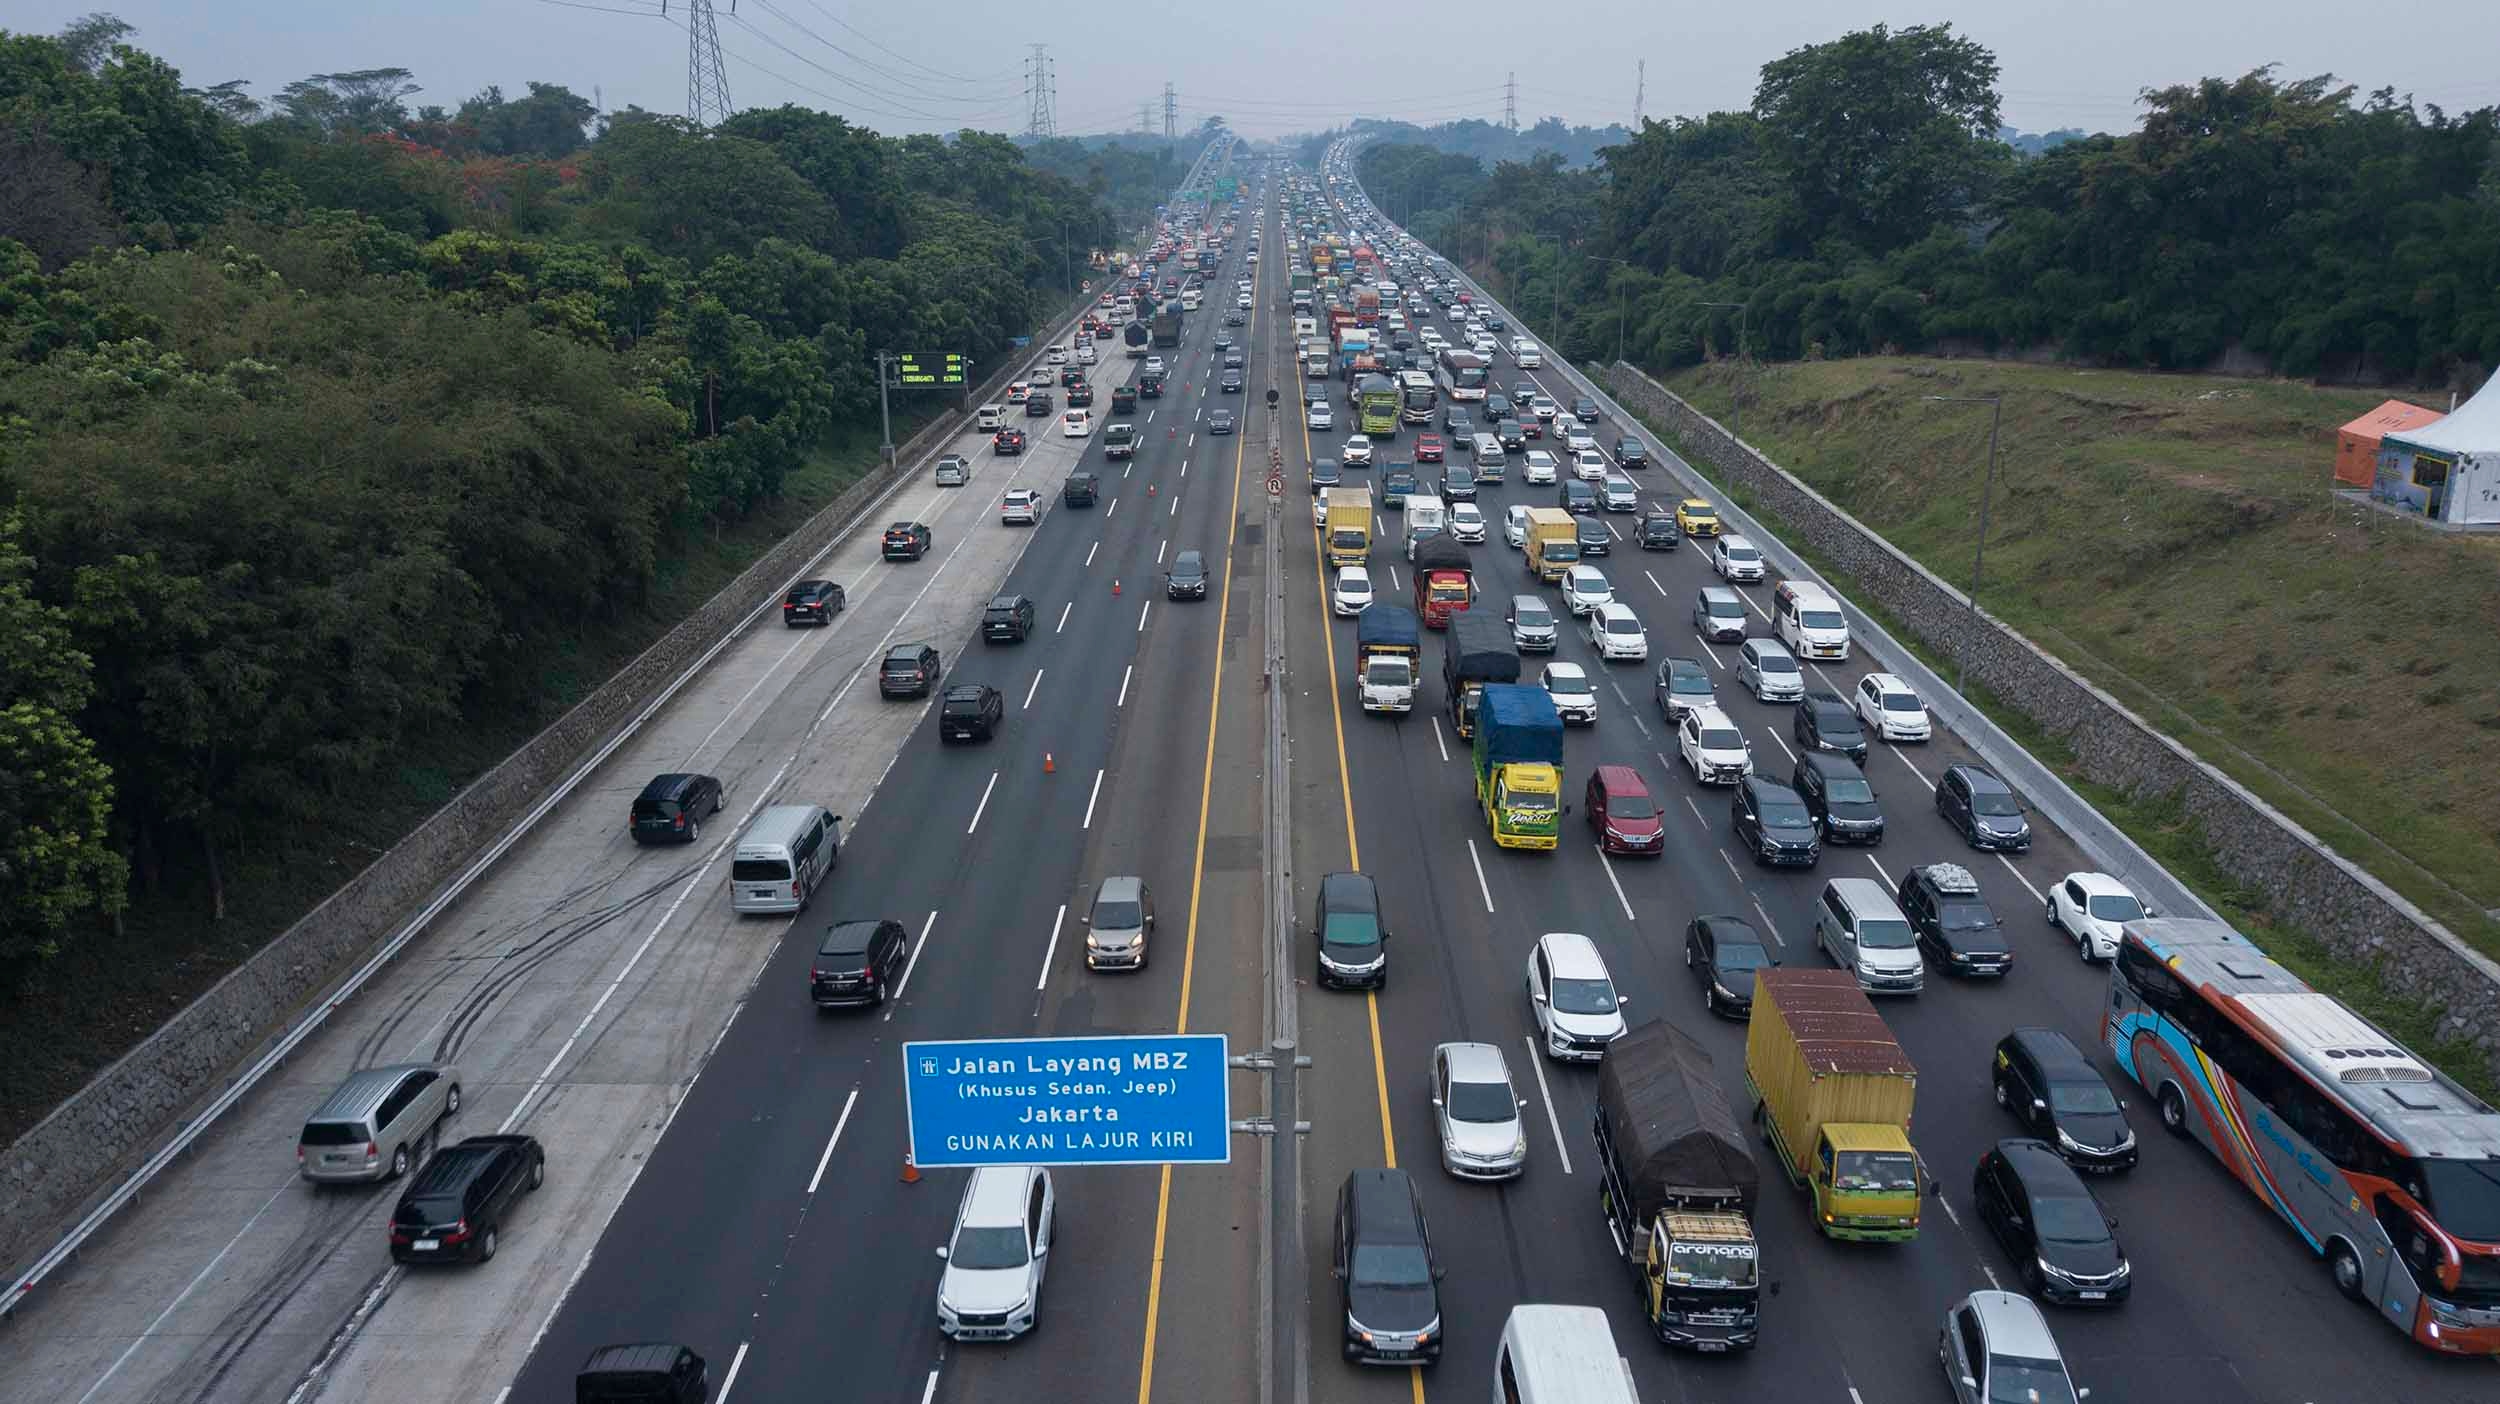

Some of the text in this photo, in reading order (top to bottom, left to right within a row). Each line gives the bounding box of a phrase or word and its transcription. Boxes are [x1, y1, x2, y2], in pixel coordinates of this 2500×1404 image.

[947, 1052, 1188, 1076] Jalan Layang MBZ
[958, 1082, 1037, 1099] (Khusus
[1123, 1078, 1177, 1096] Jeep)
[1019, 1105, 1119, 1123] Jakarta
[947, 1131, 1193, 1151] GUNAKAN LAJUR KIRI
